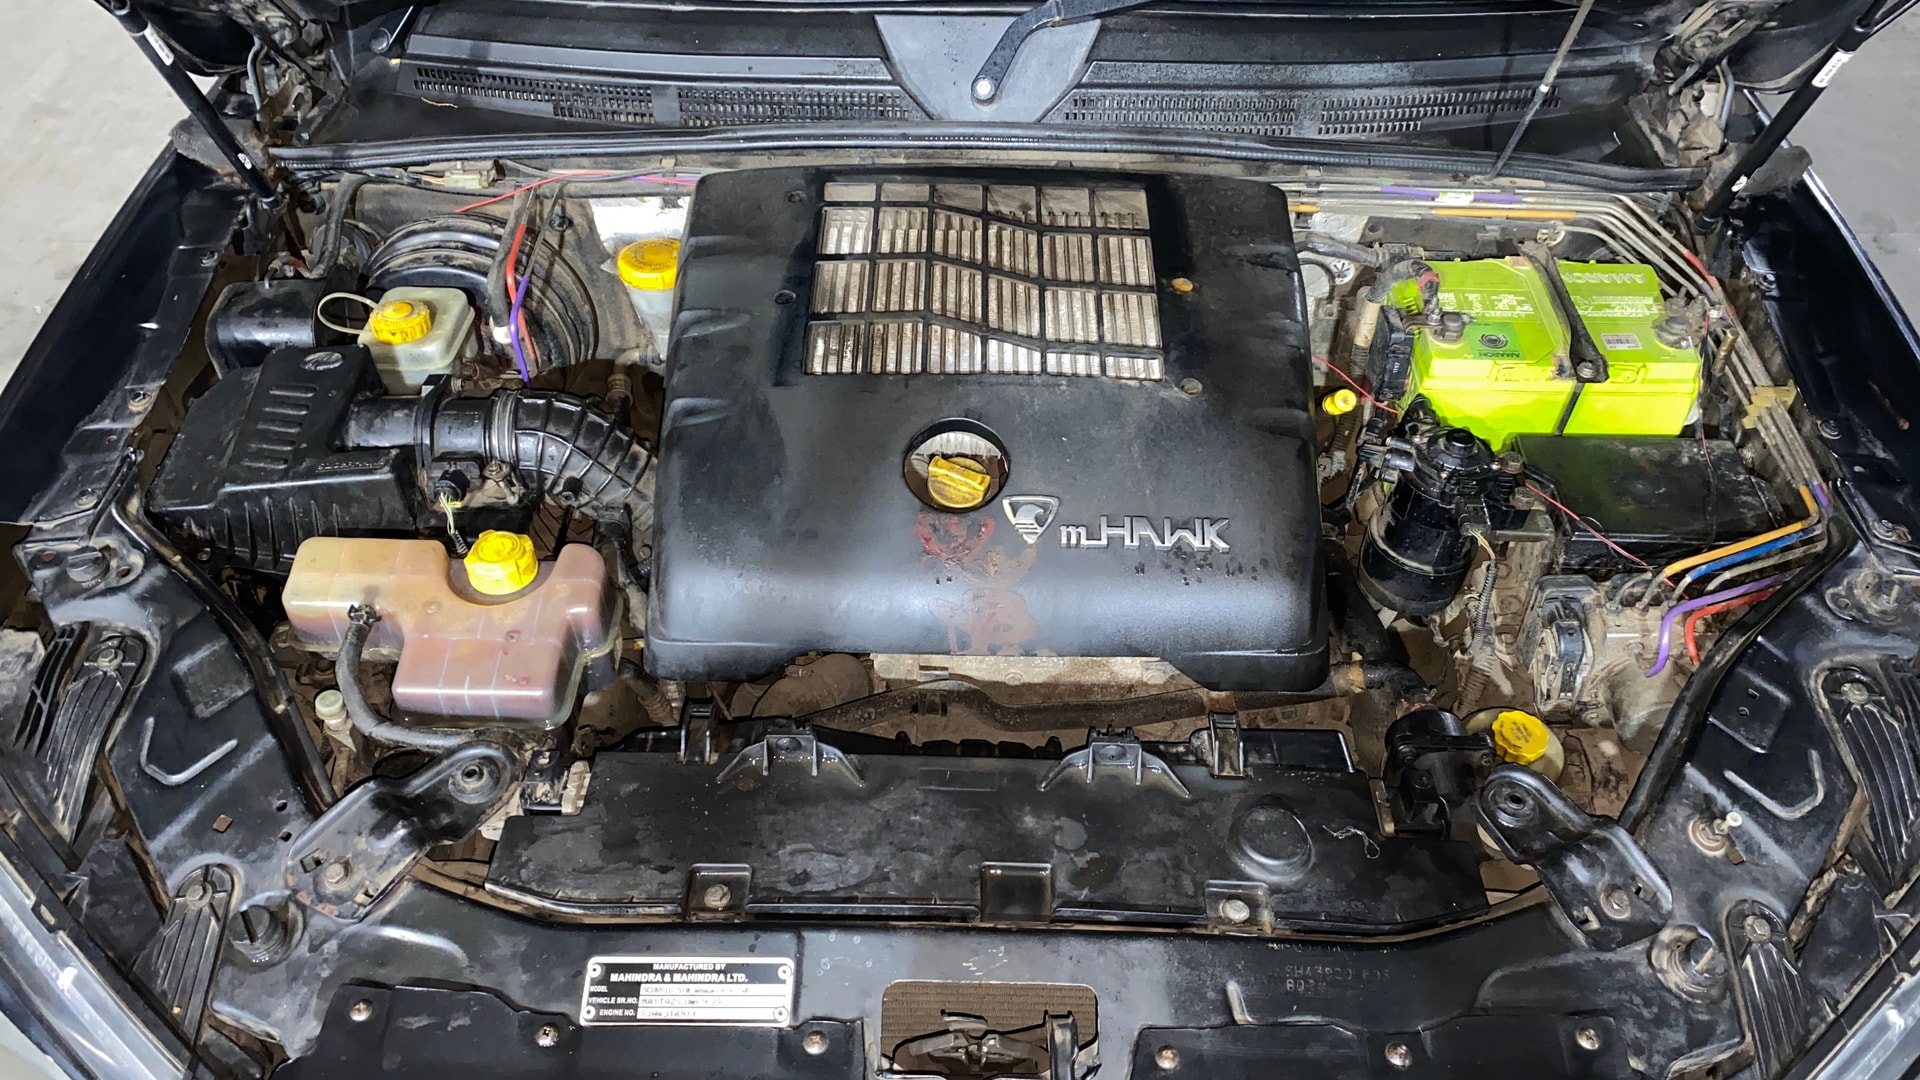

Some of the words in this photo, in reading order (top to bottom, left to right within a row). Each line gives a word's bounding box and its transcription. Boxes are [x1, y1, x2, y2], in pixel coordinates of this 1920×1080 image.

[1478, 350, 1521, 359] AMARON
[652, 963, 714, 971] MANUFACTURED
[715, 963, 727, 971] BY
[609, 972, 662, 983] MAHINDRA
[663, 973, 672, 982] &
[672, 972, 725, 983] MAHINDRA
[726, 973, 749, 983] LTD.
[589, 985, 608, 993] MODEL
[588, 996, 616, 1005] VEHICLE
[599, 1008, 623, 1017] ENGINE
[623, 1009, 636, 1017] NO.
